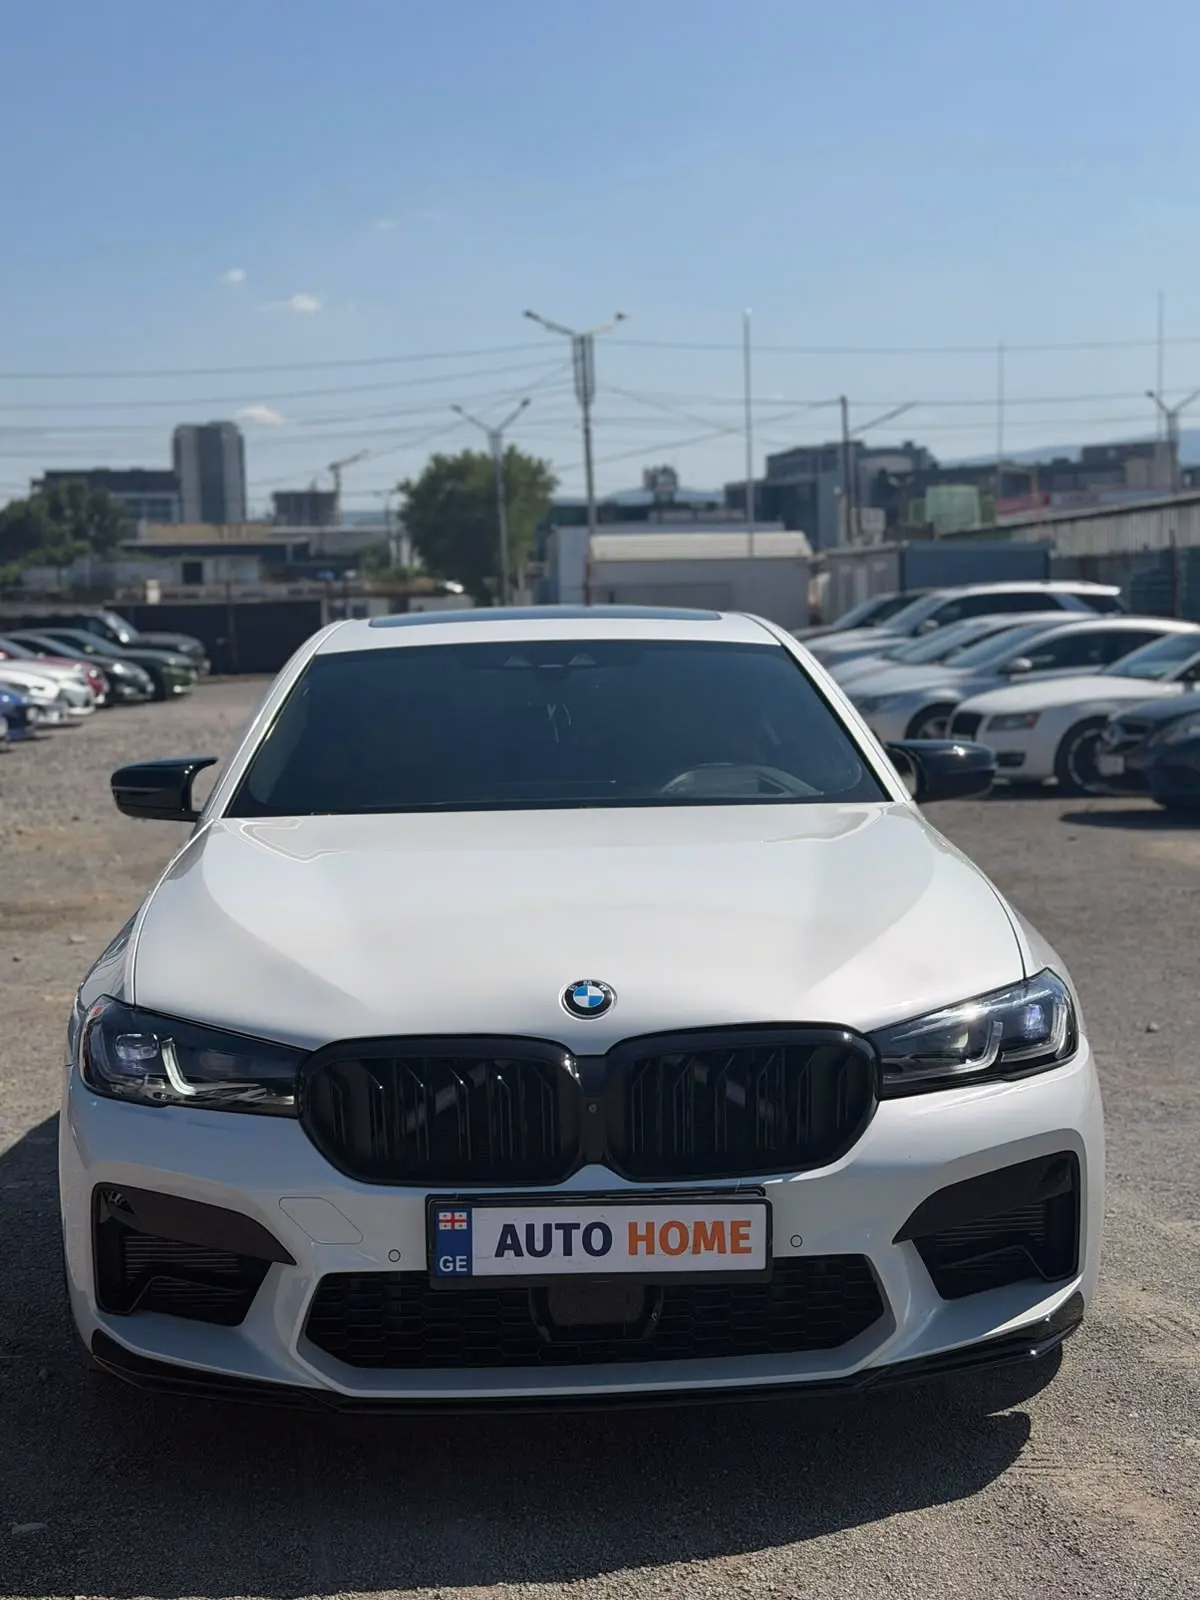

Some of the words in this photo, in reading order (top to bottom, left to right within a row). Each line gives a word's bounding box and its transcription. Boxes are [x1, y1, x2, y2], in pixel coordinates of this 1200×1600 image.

[494, 1221, 613, 1258] AUTO
[628, 1220, 752, 1256] HOME
[439, 1255, 468, 1273] GE
